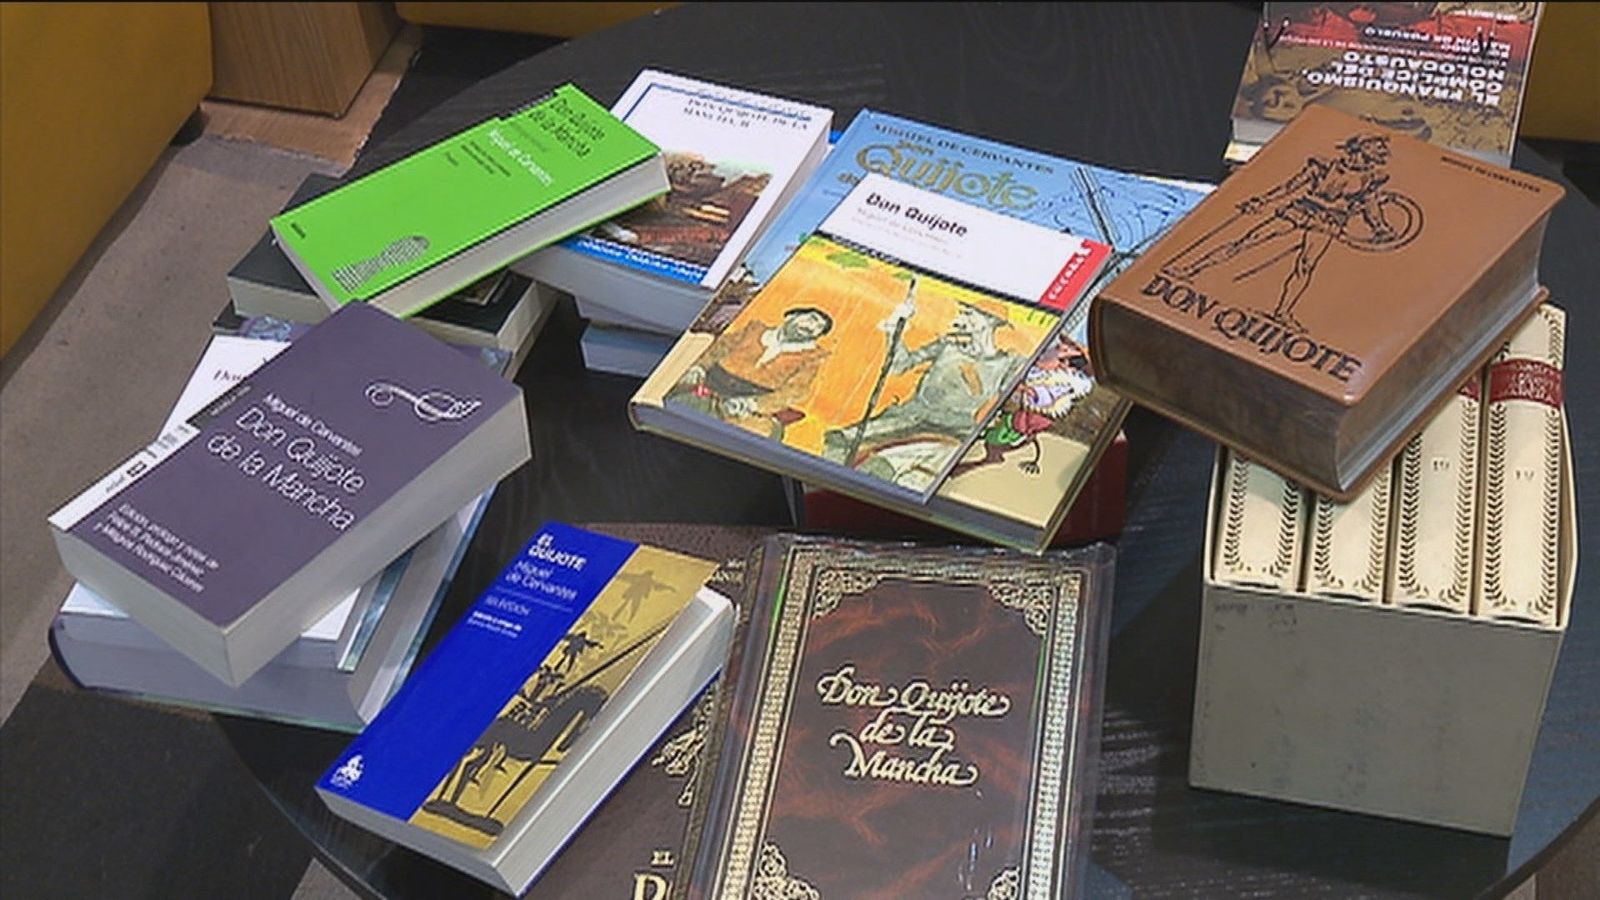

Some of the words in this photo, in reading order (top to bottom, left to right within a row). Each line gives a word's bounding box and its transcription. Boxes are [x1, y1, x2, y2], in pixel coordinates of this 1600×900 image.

[1332, 60, 1375, 77] DEL
[1344, 51, 1506, 80] HOLOCAUSTO
[1471, 92, 1500, 106] EL
[937, 139, 960, 151] DE
[961, 145, 1054, 175] CERVANTES
[856, 144, 1039, 210] Quijote
[865, 191, 901, 214] Don
[904, 206, 968, 238] Quijote
[1141, 273, 1219, 319] DON
[1211, 306, 1363, 384] QUIJOTE
[236, 406, 287, 447] Don
[286, 436, 365, 494] Quijote
[207, 433, 242, 461] de
[238, 449, 266, 476] la
[262, 463, 355, 531] Mancha
[513, 560, 553, 579] Miguel
[528, 544, 588, 572] QUIJOTE
[505, 571, 522, 584] de
[521, 574, 579, 600] Cervantes
[816, 664, 898, 706] Don
[899, 680, 1012, 725] Quijote
[859, 707, 906, 744] de
[907, 711, 955, 749] la
[828, 732, 980, 786] Mancha
[650, 850, 675, 865] EL
